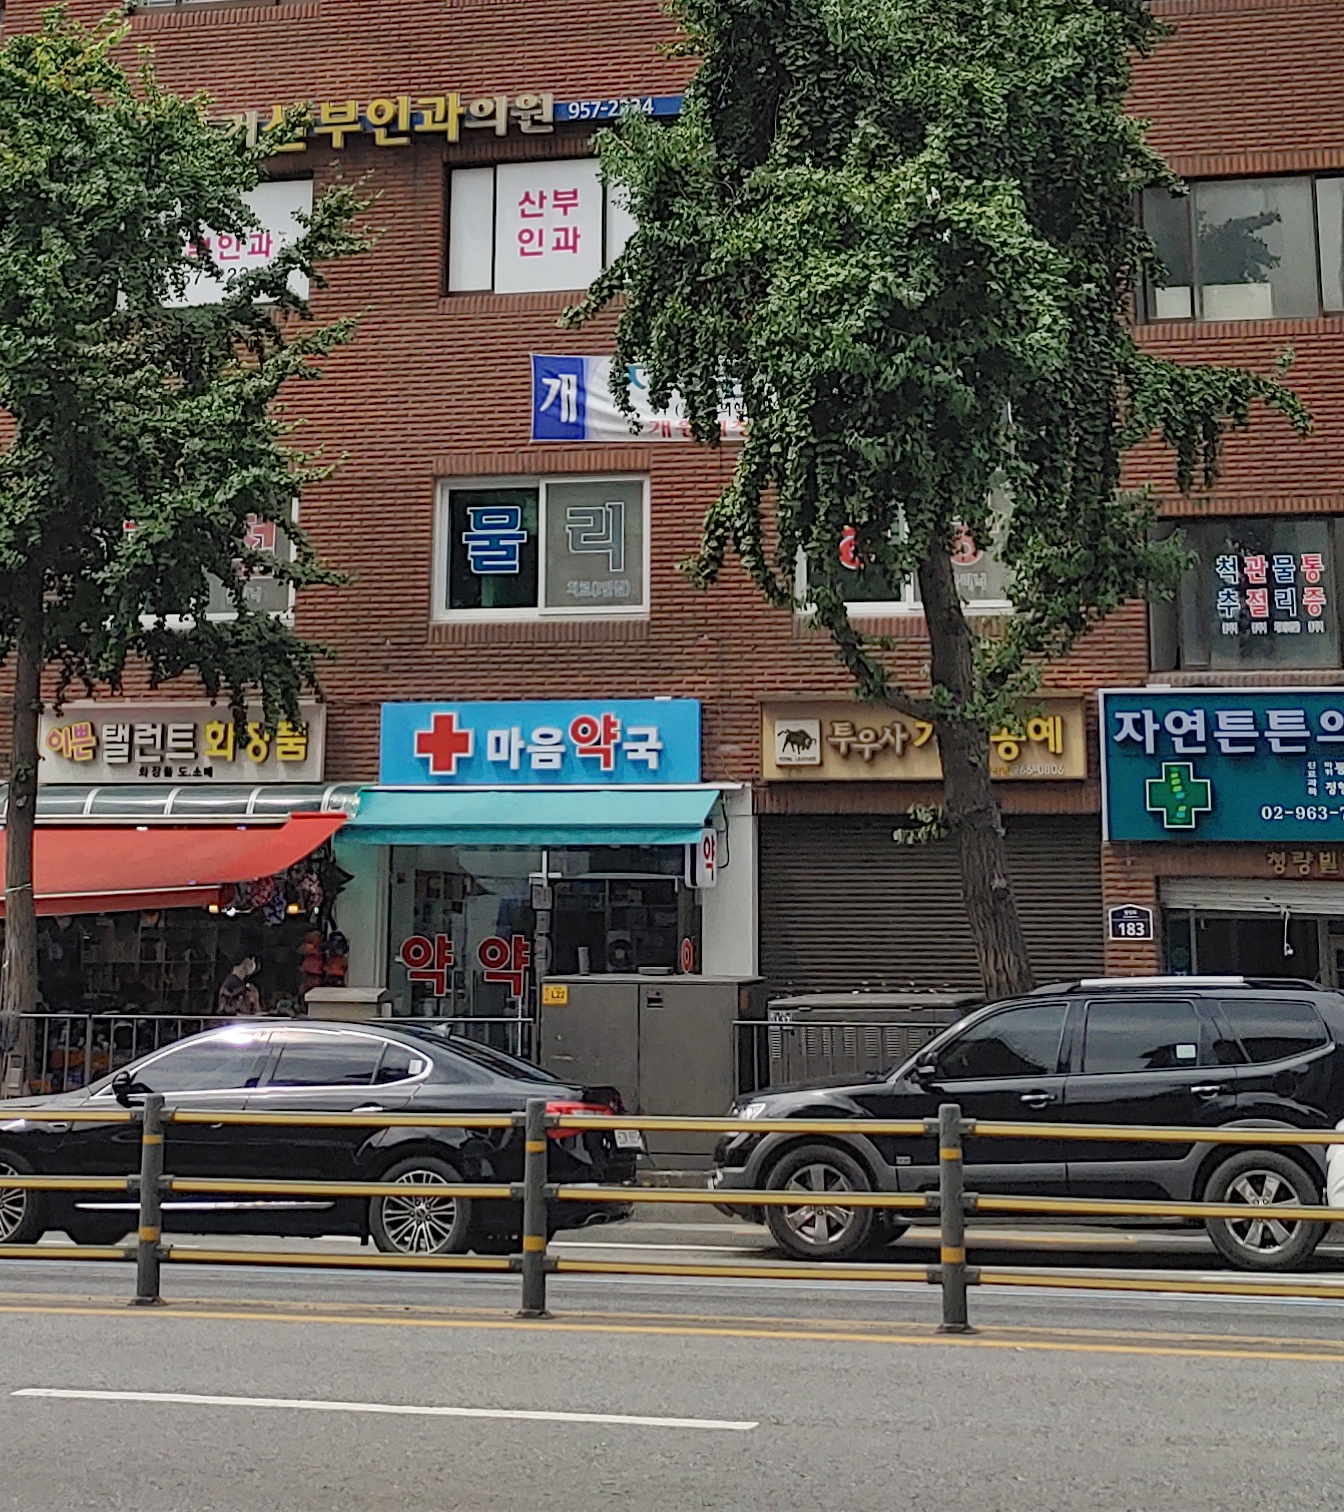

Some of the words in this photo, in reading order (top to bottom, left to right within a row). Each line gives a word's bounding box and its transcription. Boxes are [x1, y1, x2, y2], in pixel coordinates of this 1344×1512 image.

[518, 188, 579, 218] 산부
[517, 227, 580, 257] 인과
[46, 720, 96, 762] 이쁜
[102, 723, 198, 764] 탤런트
[486, 712, 665, 772] 마음약국
[828, 721, 908, 763] 투우사
[1118, 922, 1145, 936] 183
[400, 932, 455, 998] 약
[476, 934, 531, 998] 약
